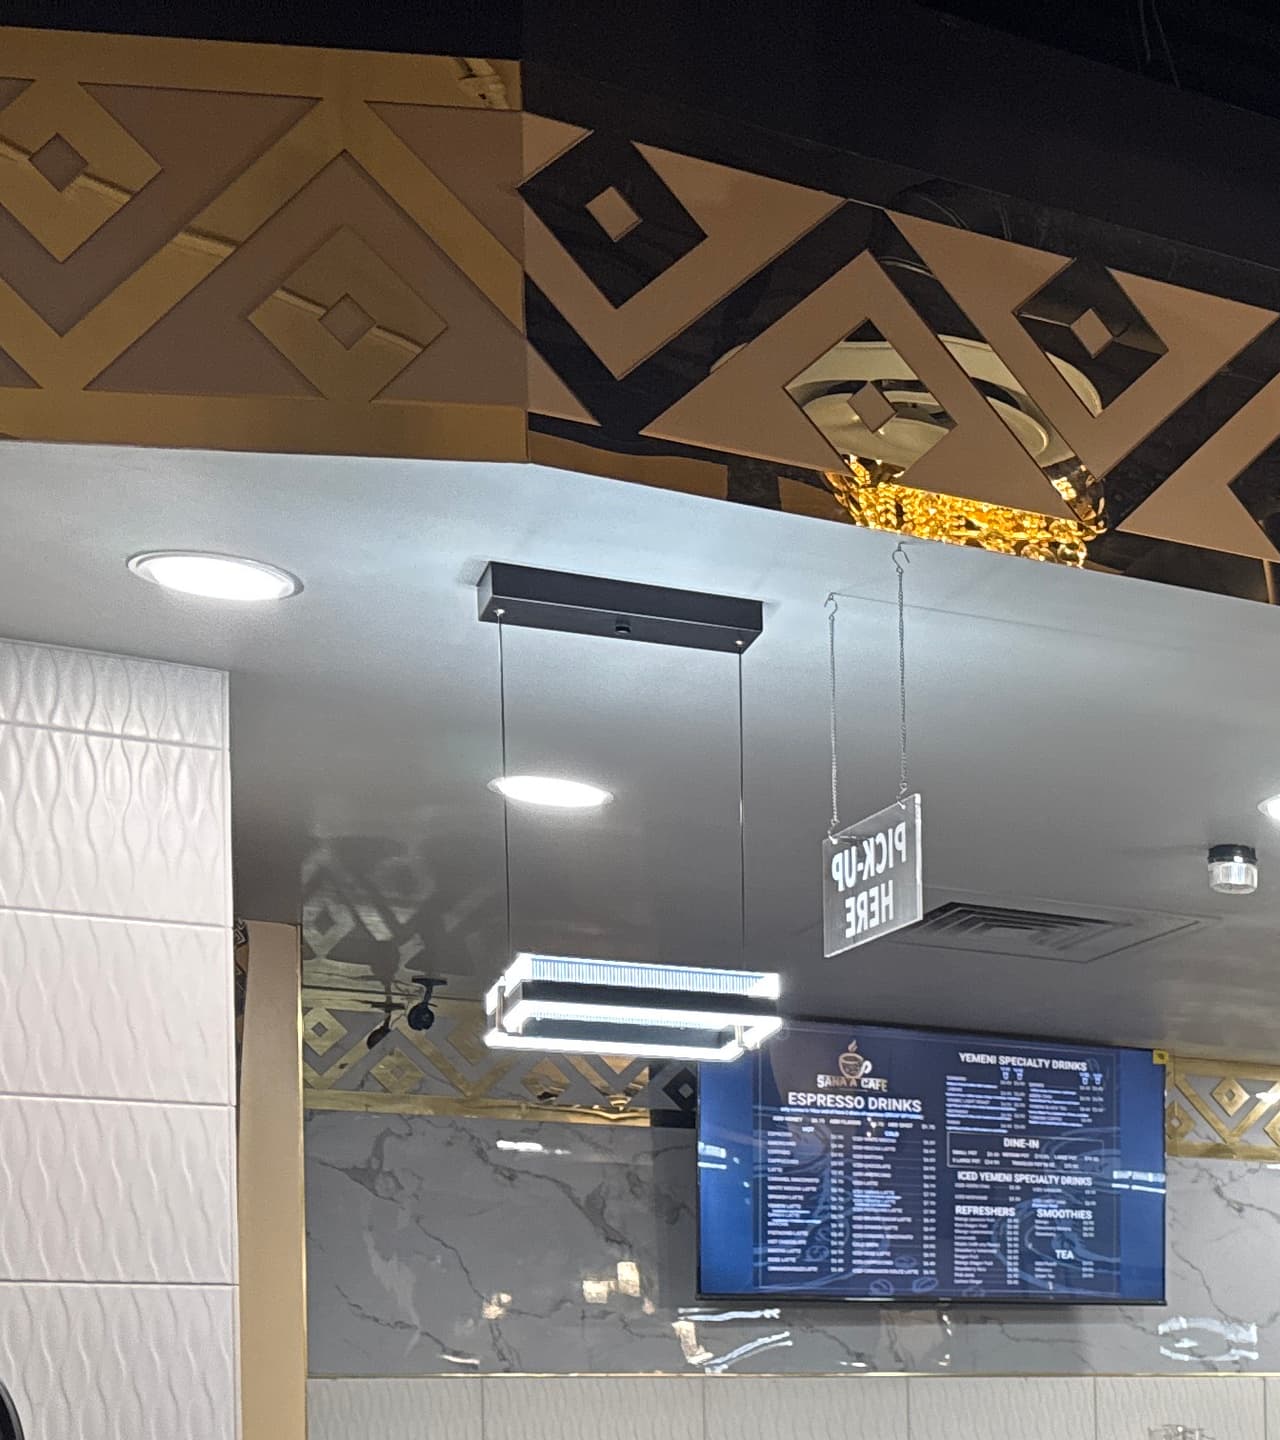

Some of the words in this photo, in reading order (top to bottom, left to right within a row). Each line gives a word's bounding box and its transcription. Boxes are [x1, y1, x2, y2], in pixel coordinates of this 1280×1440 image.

[958, 1052, 997, 1065] YEMENI
[999, 1055, 1050, 1069] SPECIALTY
[1052, 1060, 1087, 1072] DRINKS
[788, 1092, 864, 1109] ESPRESSO
[867, 1097, 922, 1113] DRINKS
[1003, 1137, 1039, 1149] DINE-IN
[957, 1171, 978, 1181] ICED
[980, 1172, 1013, 1184] YEMENI
[1014, 1173, 1060, 1186] SPECIALTY
[1061, 1176, 1092, 1186] DRINKS
[955, 1205, 1016, 1217] REFRESHERS
[1036, 1209, 1092, 1220] SMOOTHIES
[1055, 1249, 1074, 1260] TEA
